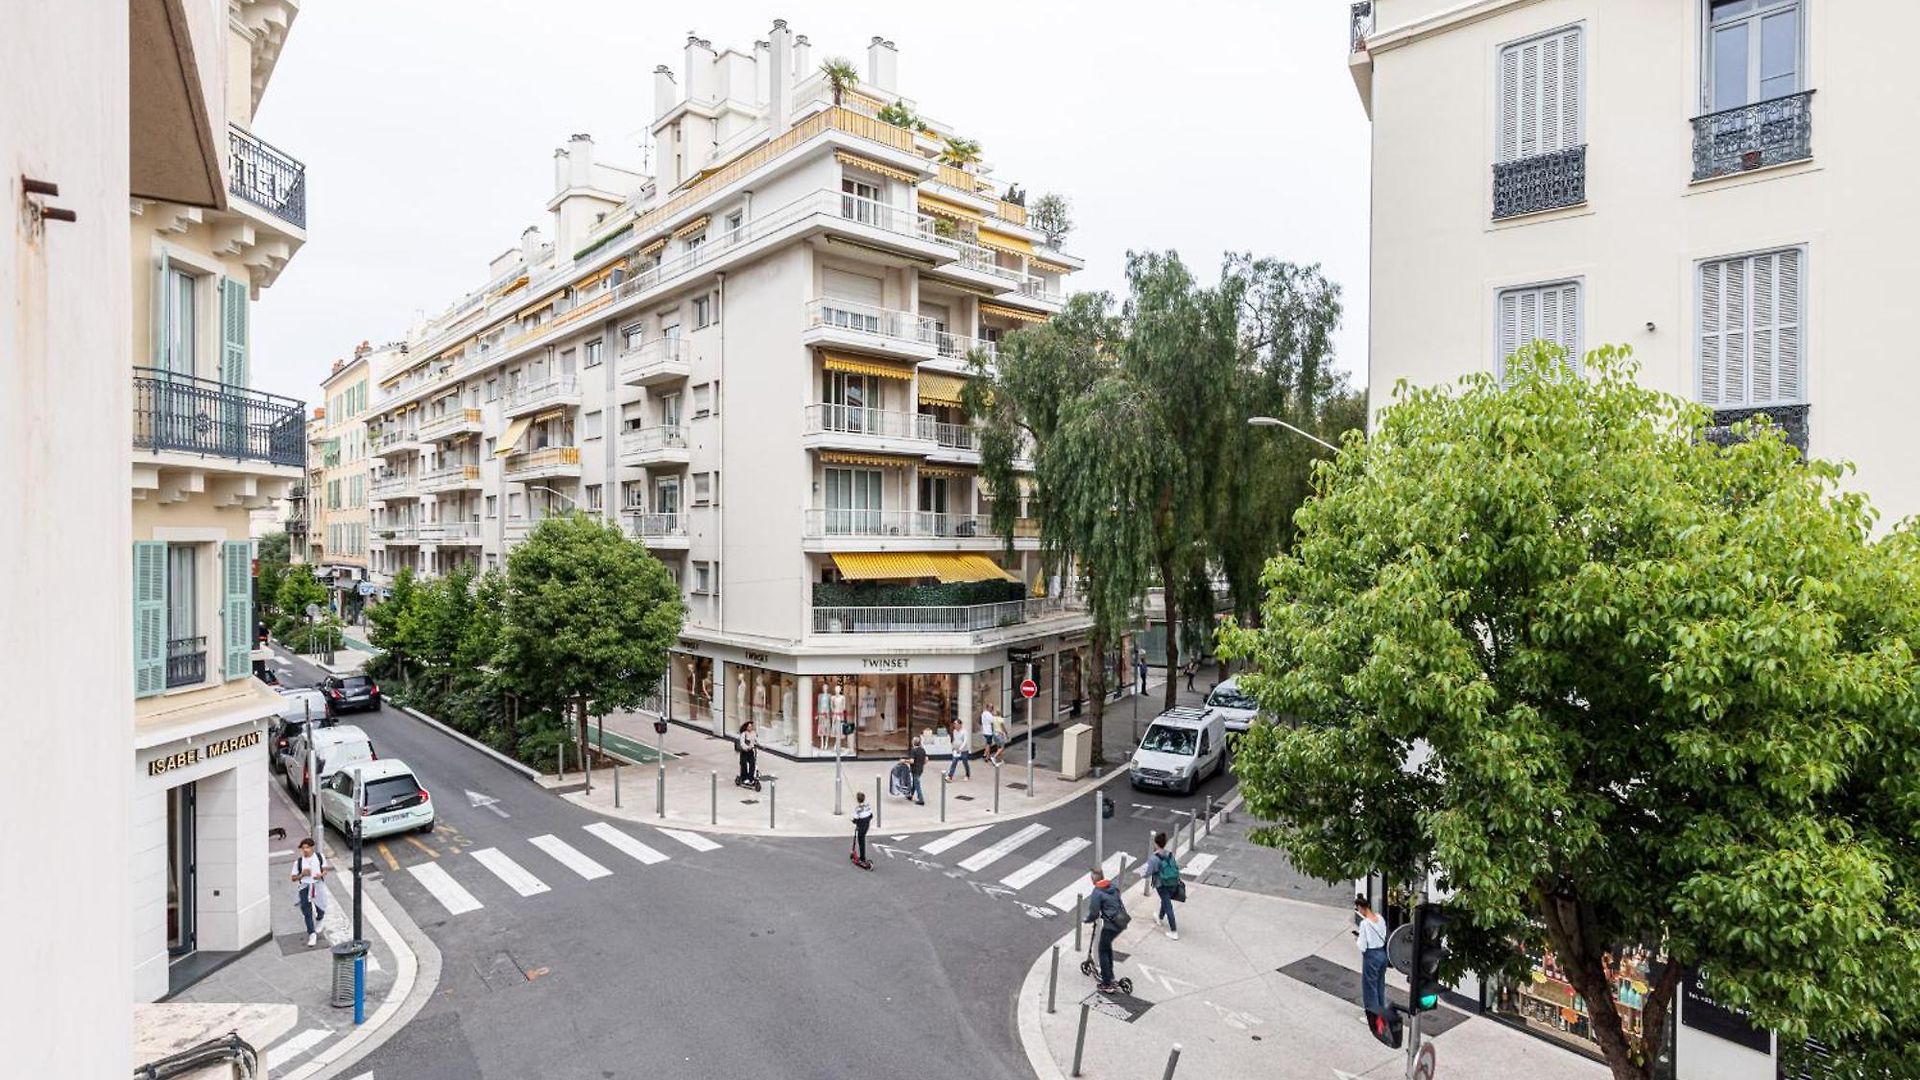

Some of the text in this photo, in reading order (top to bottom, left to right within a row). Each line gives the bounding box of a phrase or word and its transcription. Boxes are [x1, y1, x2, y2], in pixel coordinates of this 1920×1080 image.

[862, 658, 910, 668] TWINSET
[149, 730, 263, 776] ISABEL MARANT
